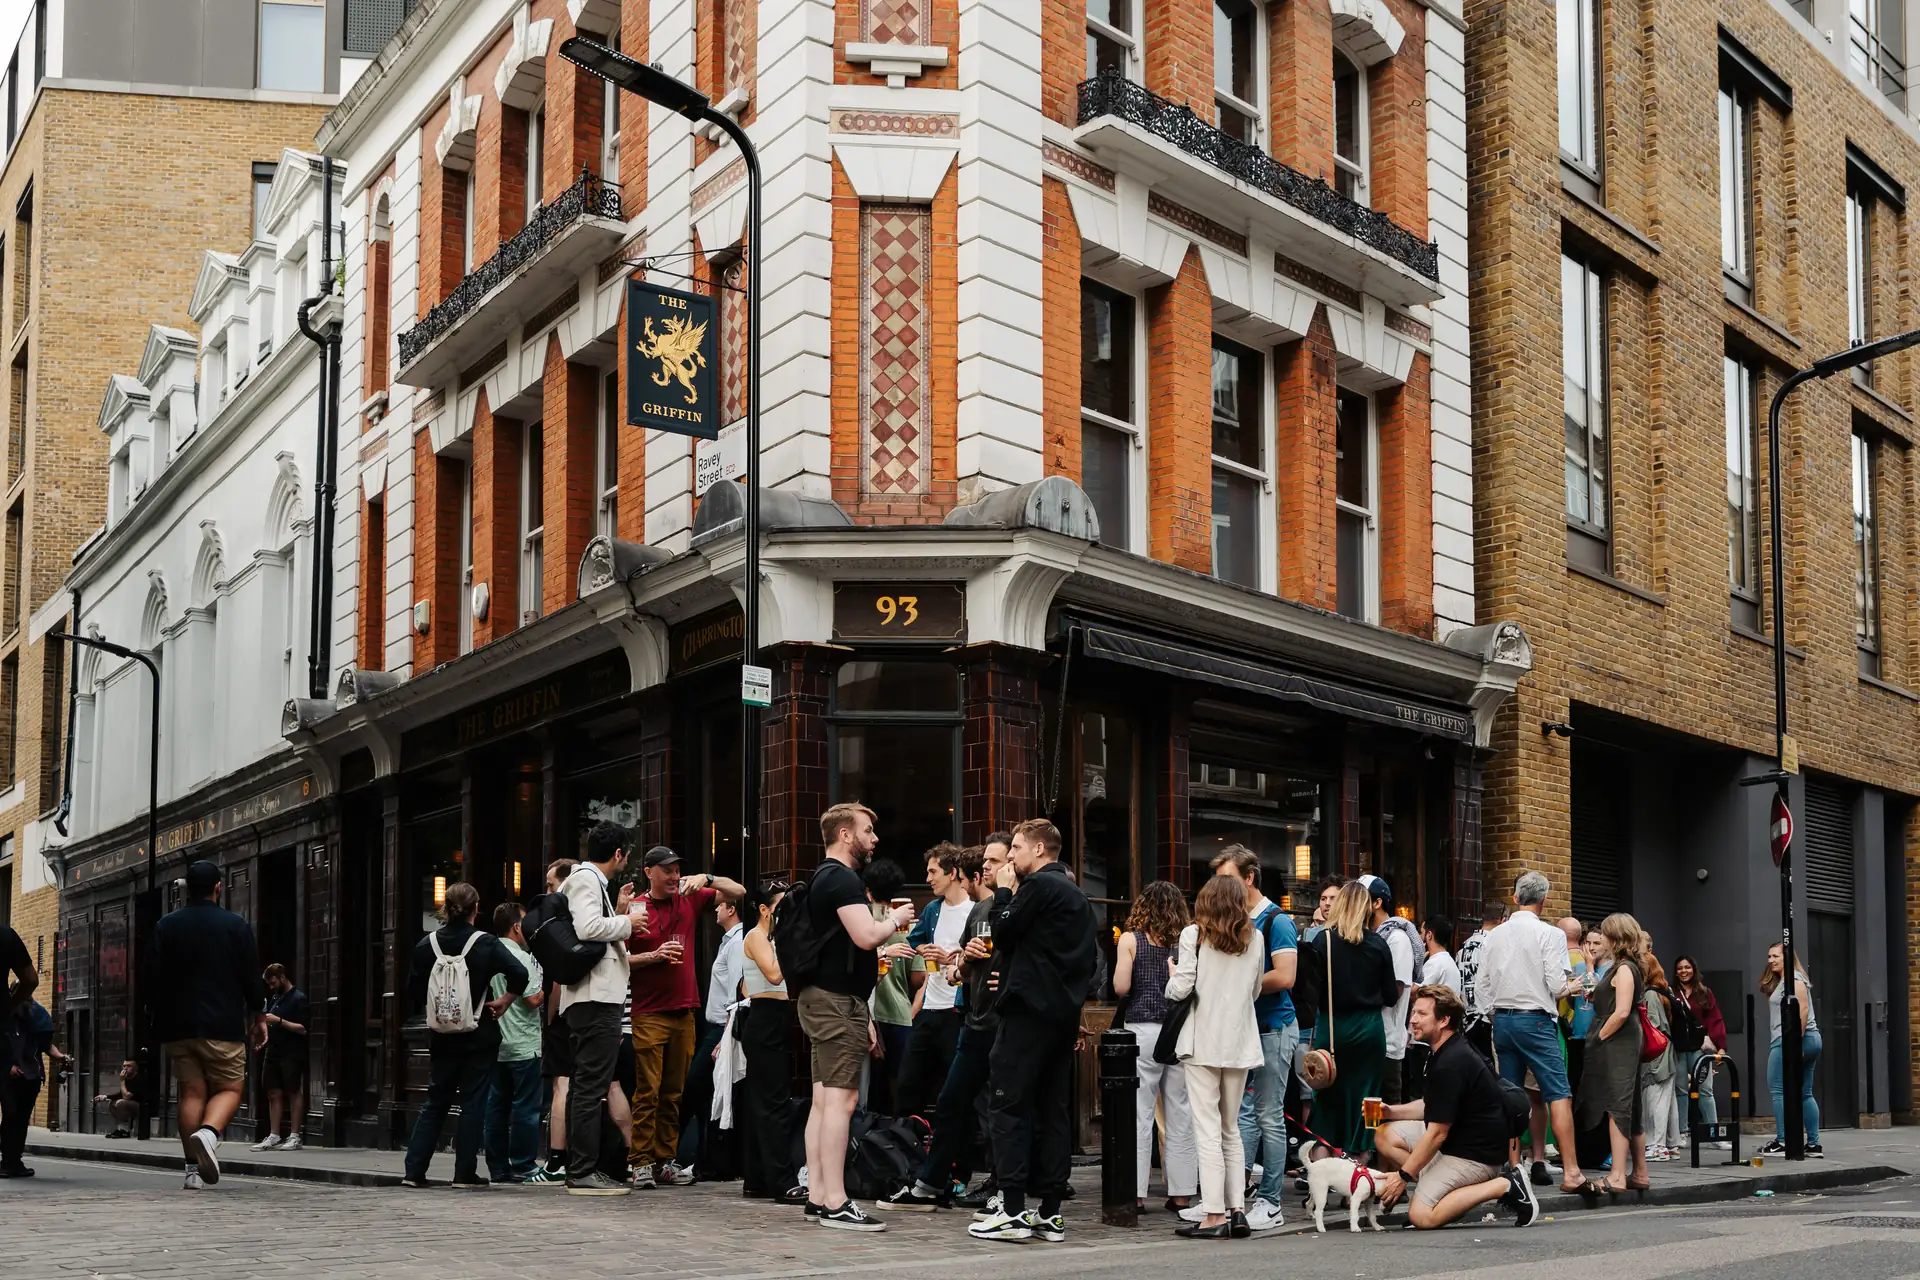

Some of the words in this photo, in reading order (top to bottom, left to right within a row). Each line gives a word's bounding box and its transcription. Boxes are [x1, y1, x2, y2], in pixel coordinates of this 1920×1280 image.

[658, 294, 687, 310] THE
[642, 402, 702, 423] GRIFFIN
[698, 452, 721, 473] Ravey
[698, 465, 723, 488] Street
[725, 463, 736, 475] EC2
[876, 596, 918, 626] 93
[682, 612, 745, 661] CHARRINGTO
[455, 710, 487, 744] THE
[493, 683, 562, 729] GRIFFIN
[1395, 705, 1419, 721] THE
[1423, 712, 1465, 731] GRIFFIN
[168, 820, 205, 850] GRIFFIN
